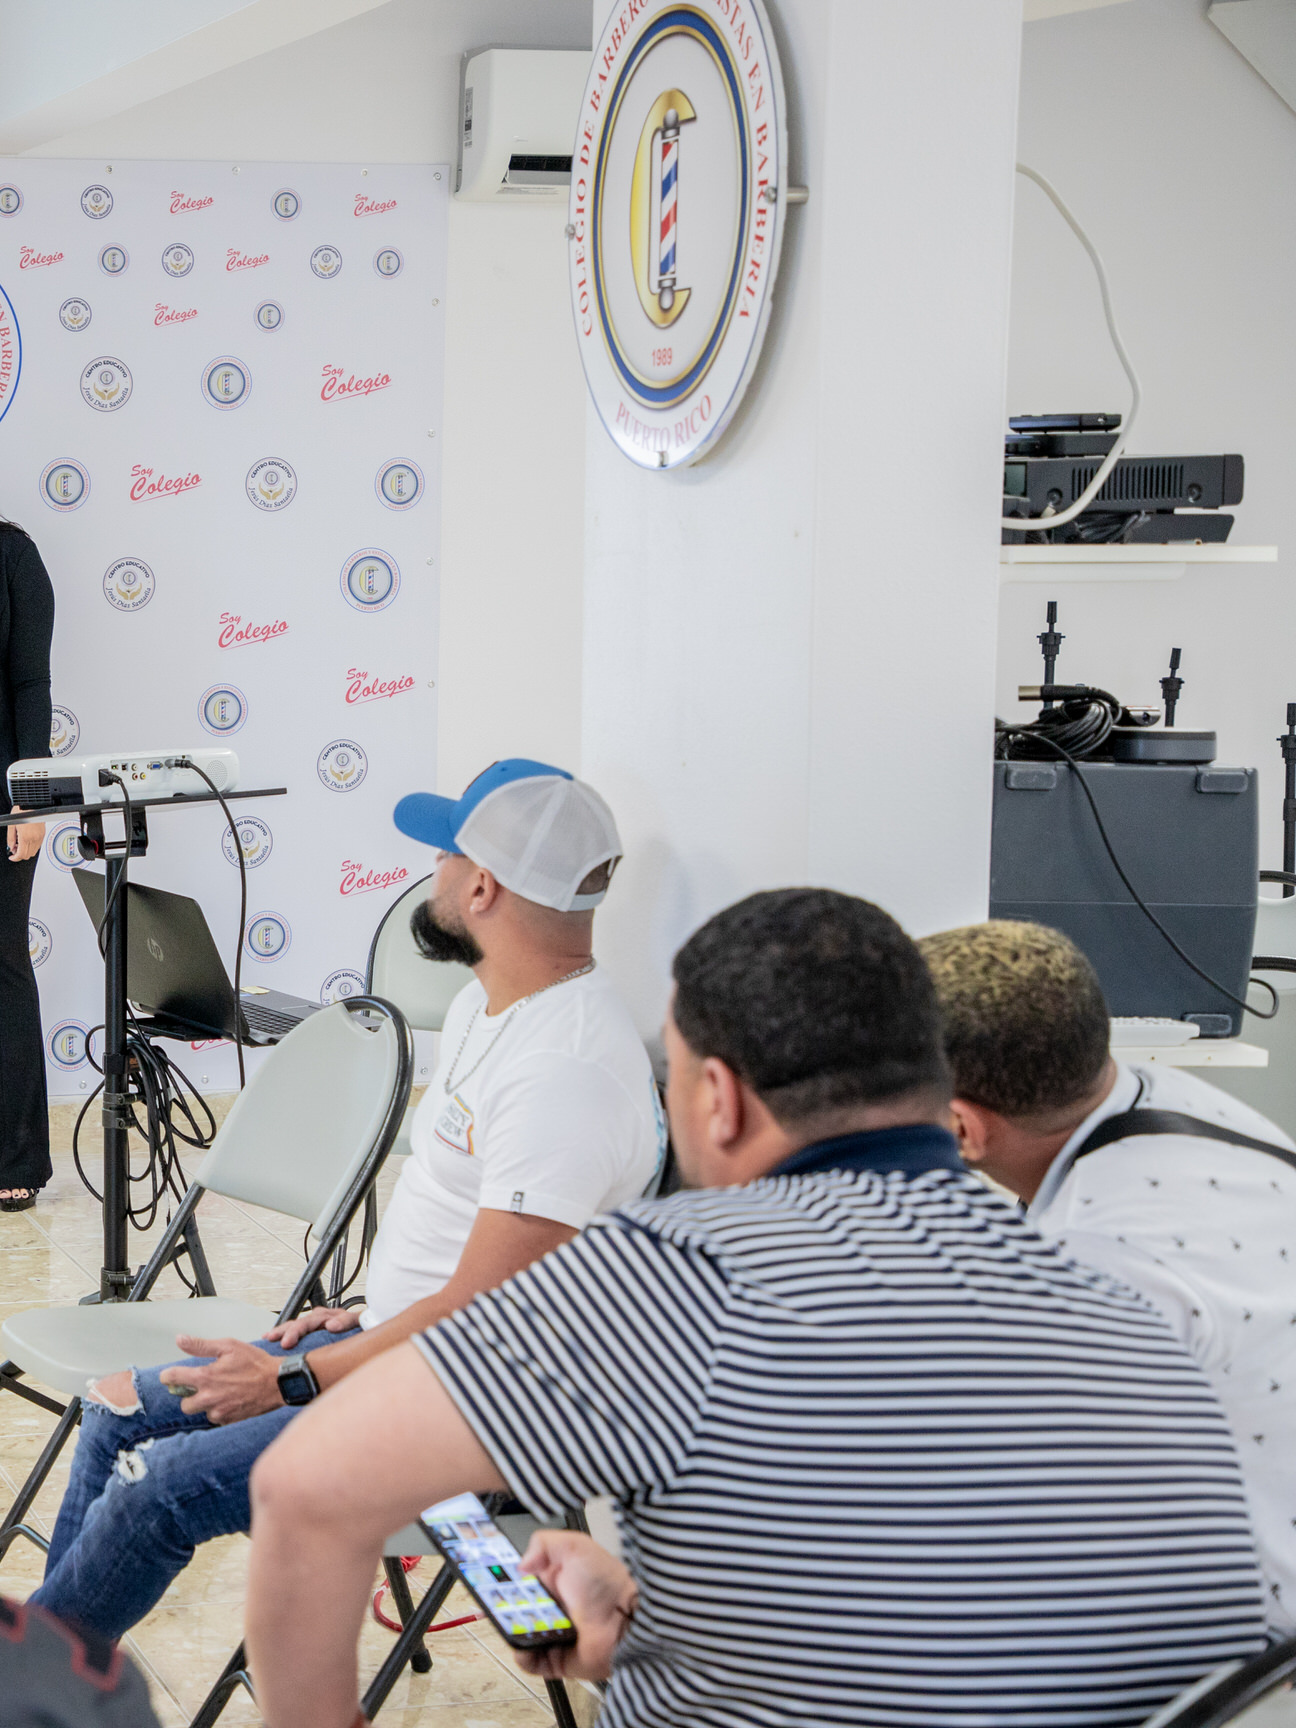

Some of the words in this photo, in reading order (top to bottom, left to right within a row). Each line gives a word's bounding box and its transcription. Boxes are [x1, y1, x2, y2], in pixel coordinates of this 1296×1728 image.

[748, 62, 765, 112] EN
[579, 120, 595, 166] DE
[170, 197, 213, 214] Colegio
[354, 200, 397, 216] Colegio
[739, 122, 769, 318] BARBERIA
[20, 253, 64, 269] Colegio
[226, 255, 269, 271] Colegio
[574, 178, 593, 336] COLEGIO
[154, 310, 197, 326] Colegio
[651, 347, 673, 367] 1989
[322, 364, 343, 377] Soy
[321, 373, 391, 401] Colegio
[616, 401, 671, 453] PUERTO
[673, 395, 712, 449] RICO
[131, 464, 153, 477] Soy
[130, 473, 202, 501] Colegio
[219, 612, 241, 624] Soy
[218, 620, 288, 648] Colegio
[346, 668, 368, 680] Soy
[345, 676, 415, 703] Colegio
[51, 708, 75, 726] DUCATIVO
[341, 860, 362, 872] Soy
[340, 867, 408, 895] Colegio
[29, 921, 47, 938] UCATIVO
